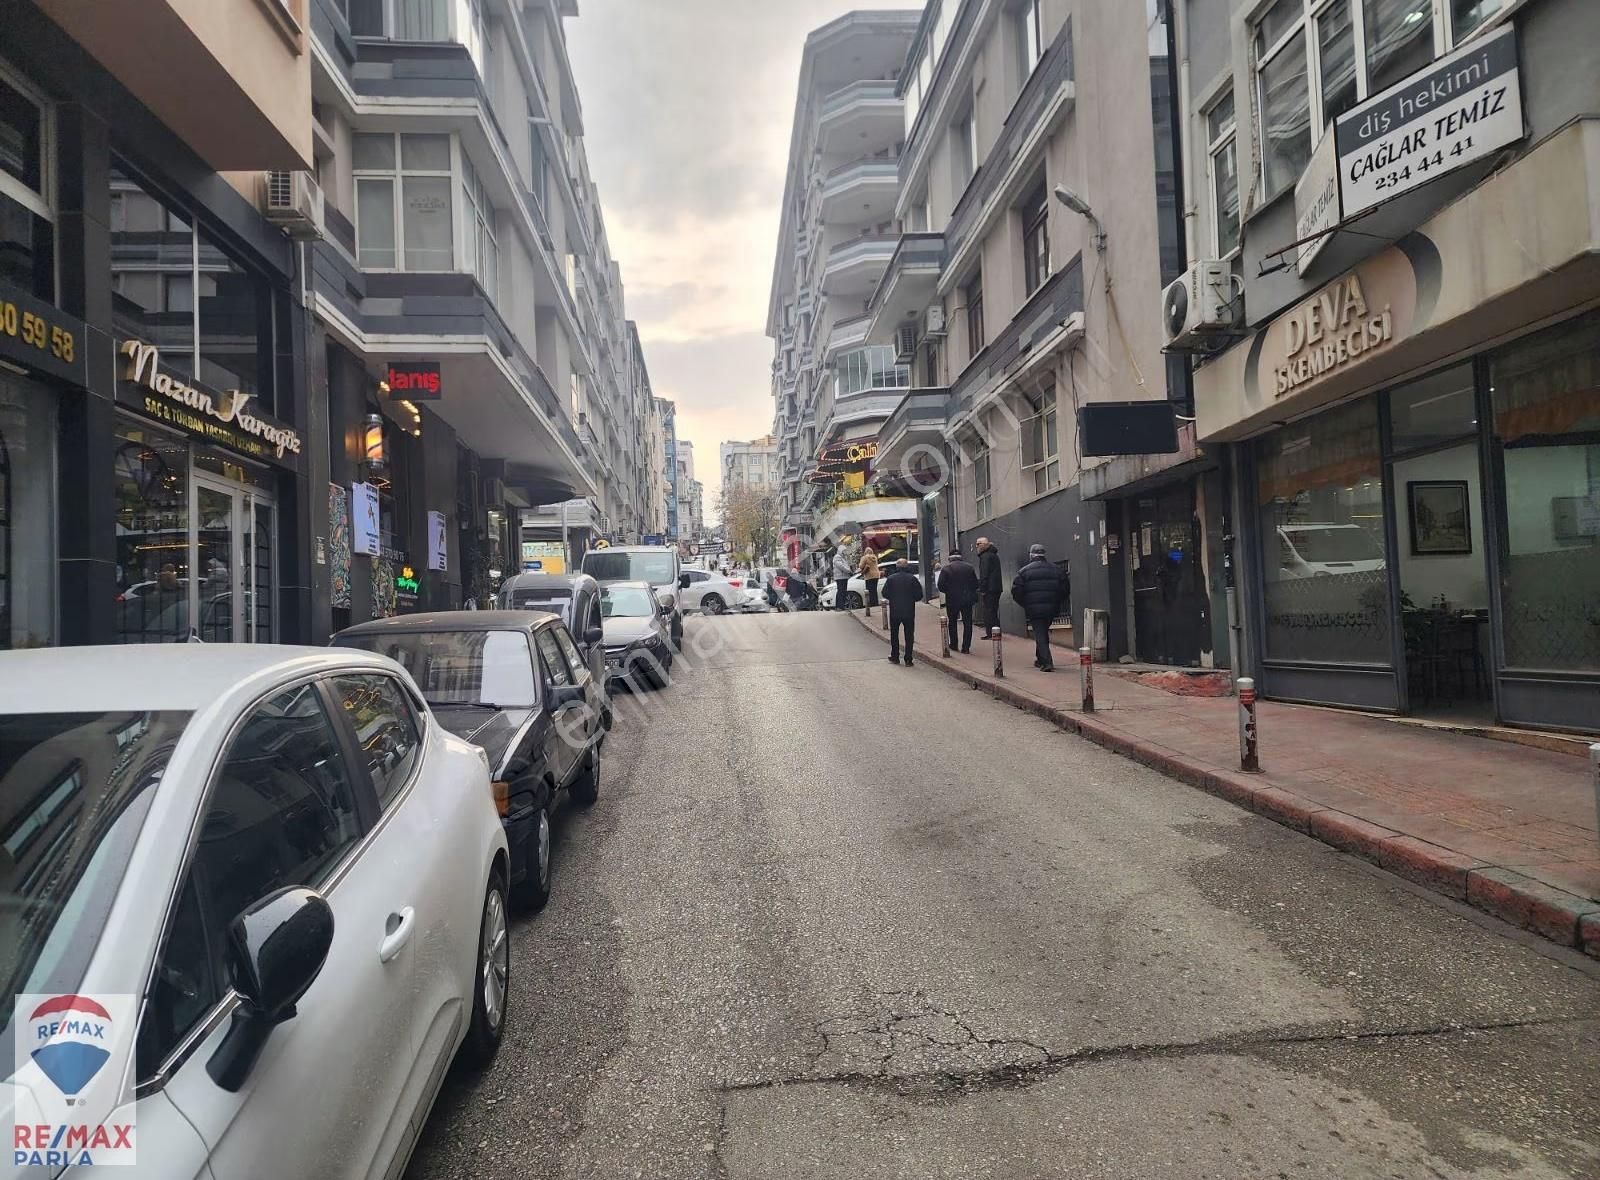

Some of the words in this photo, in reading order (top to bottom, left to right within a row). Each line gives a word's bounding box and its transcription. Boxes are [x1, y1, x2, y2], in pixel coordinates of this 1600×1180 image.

[1350, 128, 1426, 184] ÇAĞLAR
[1434, 86, 1507, 141] TEMİZ
[1358, 110, 1391, 138] diş
[1399, 53, 1489, 118] hekimi
[1375, 165, 1411, 190] 234
[1417, 150, 1444, 172] 44
[1450, 136, 1475, 157] 41
[0, 301, 17, 336] 0
[22, 311, 46, 349] 59
[51, 325, 74, 362] 58
[1285, 274, 1369, 358] DEVA
[121, 340, 216, 416] Nazan
[215, 389, 301, 460] Karagöz
[144, 397, 161, 417] SAÇ
